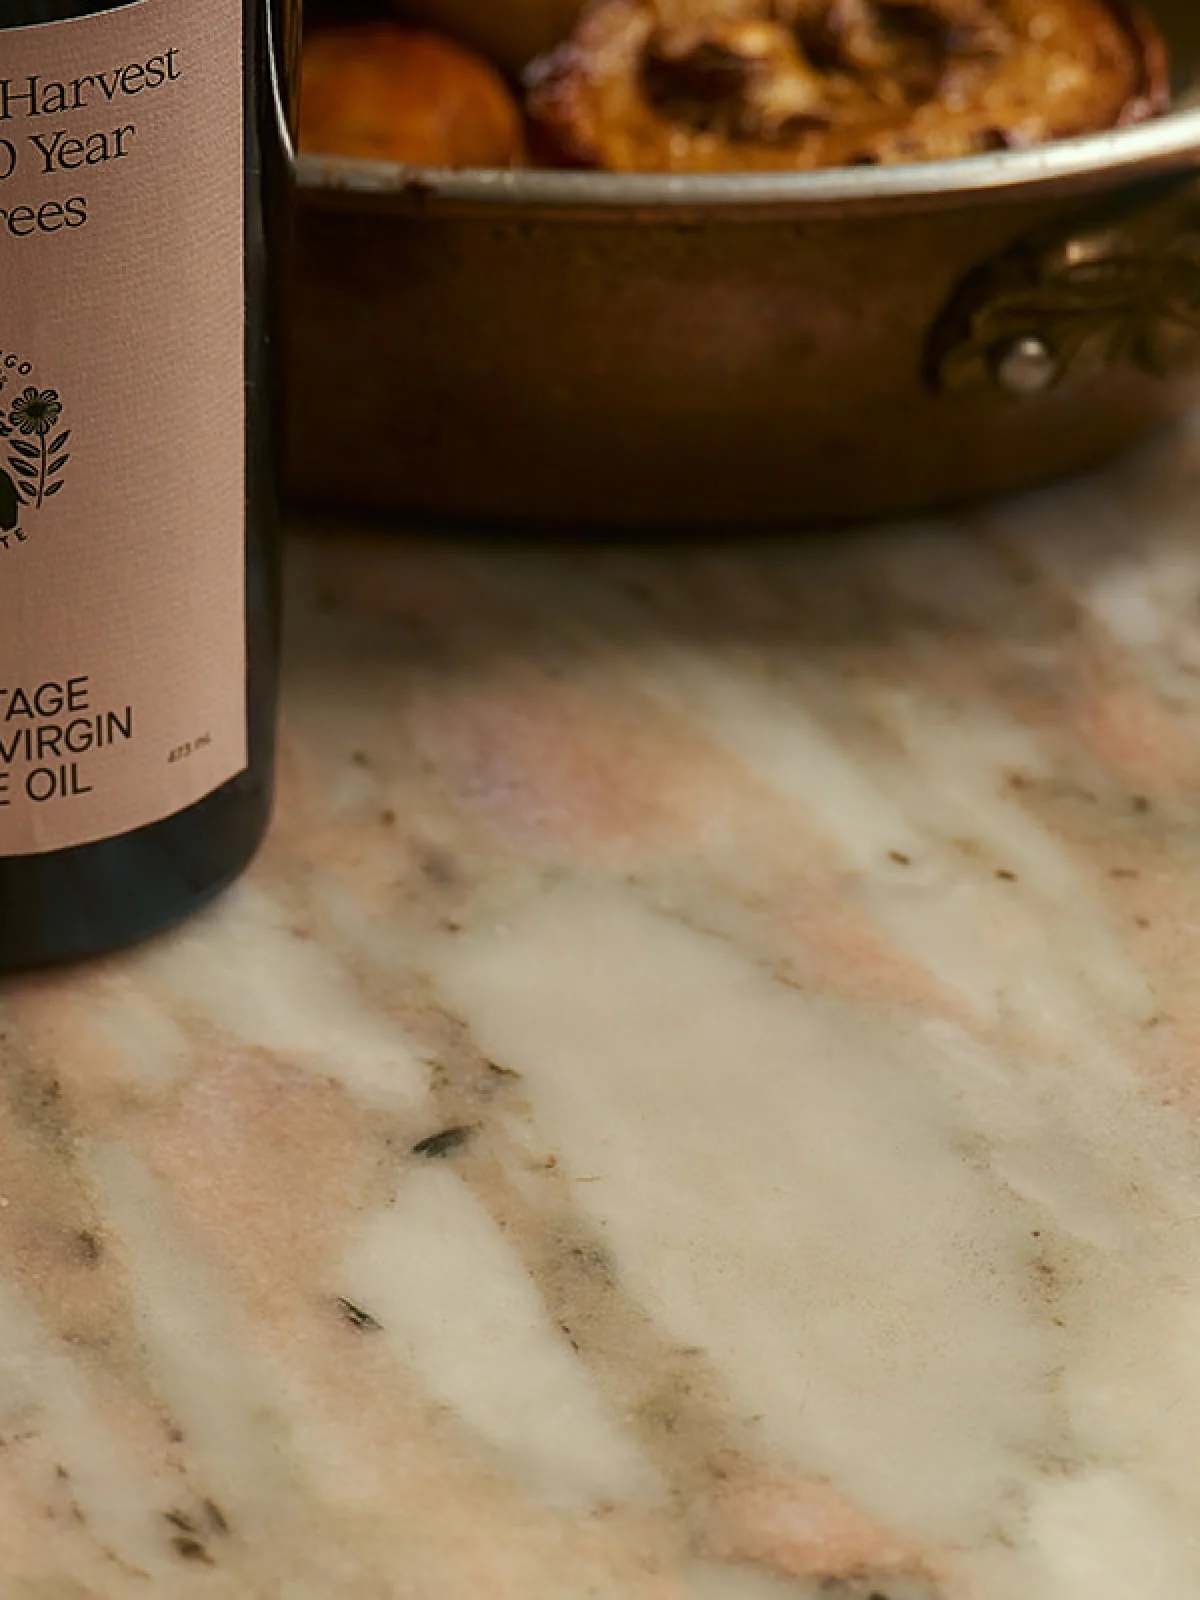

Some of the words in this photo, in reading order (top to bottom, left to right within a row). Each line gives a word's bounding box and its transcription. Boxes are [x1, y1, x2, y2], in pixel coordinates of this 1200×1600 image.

[0, 46, 181, 120] Harvest
[30, 124, 136, 174] Year
[25, 763, 92, 802] OIL
